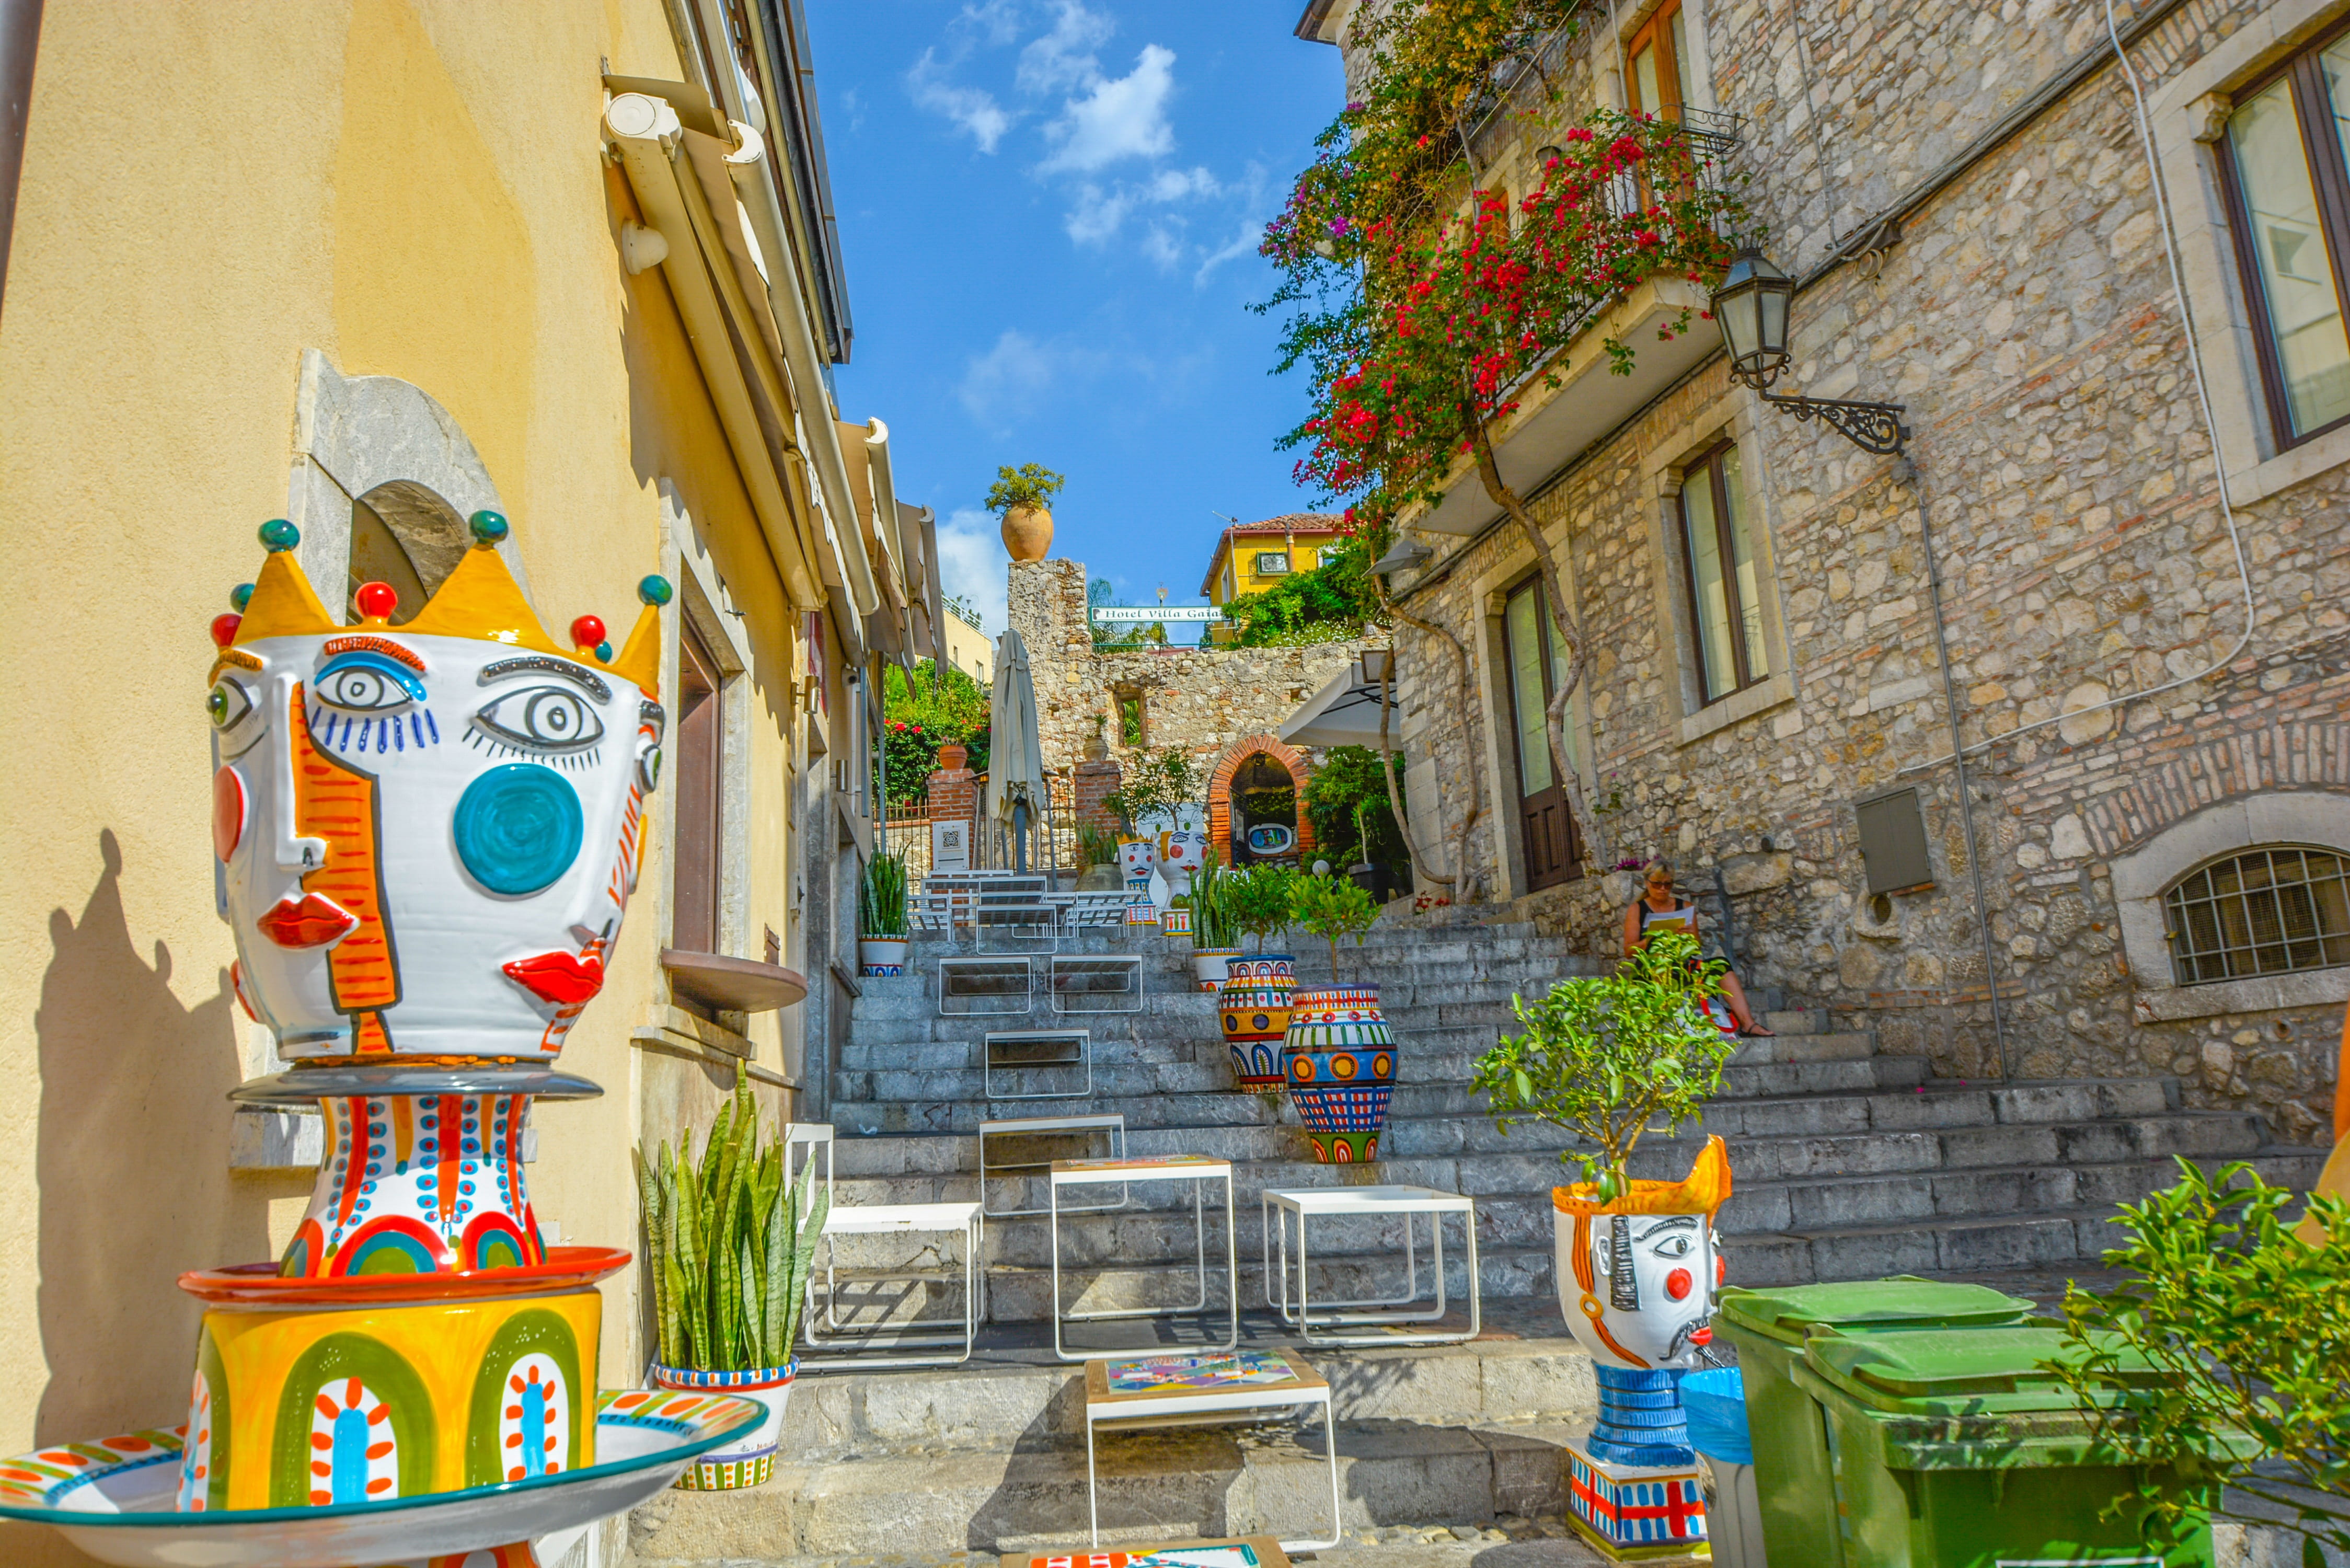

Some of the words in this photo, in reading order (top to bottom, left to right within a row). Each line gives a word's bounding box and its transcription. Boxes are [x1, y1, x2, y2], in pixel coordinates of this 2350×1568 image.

[1105, 609, 1142, 618] Hotel
[1148, 609, 1181, 618] Villa
[1187, 609, 1218, 618] Gaia
